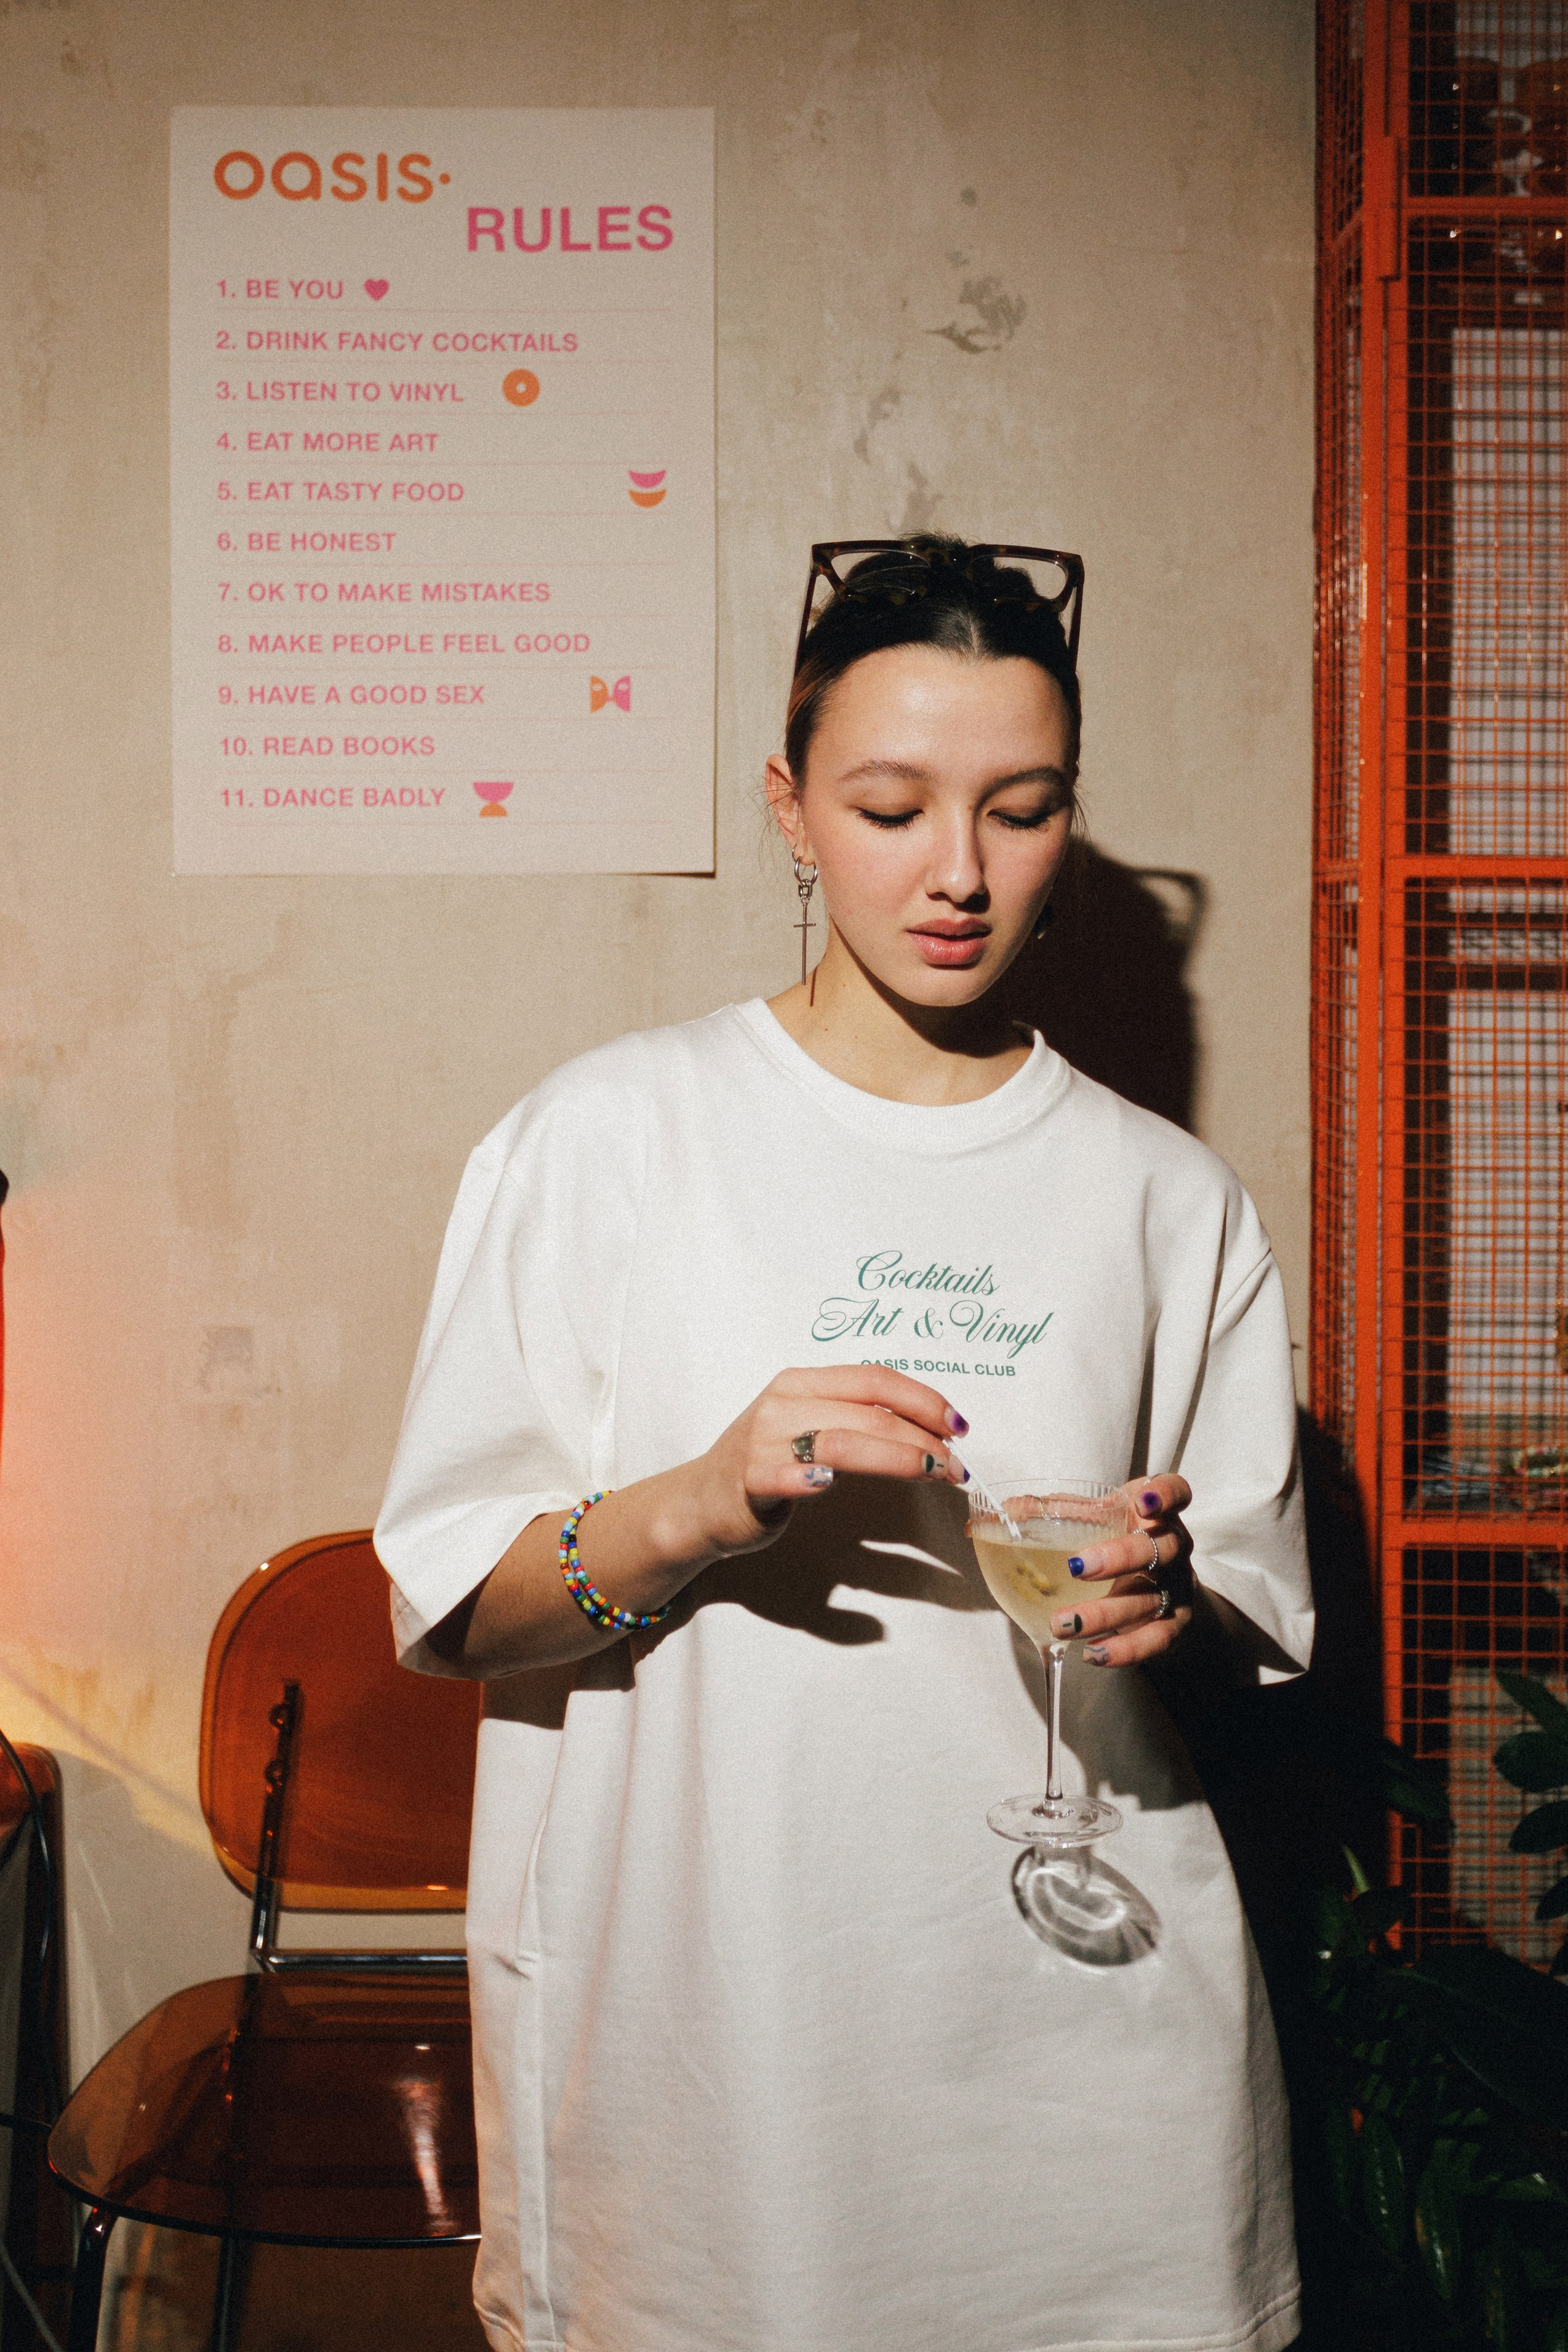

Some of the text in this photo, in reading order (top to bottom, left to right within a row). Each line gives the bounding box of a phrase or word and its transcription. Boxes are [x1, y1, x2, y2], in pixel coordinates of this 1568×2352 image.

[467, 205, 674, 253] RULES
[217, 278, 344, 301] 1. BE YOU
[216, 330, 578, 353] 2. DRINK FANCY COCKTAILS
[216, 380, 464, 403] 3. LISTEN TO VINYL
[216, 431, 439, 453] 4. EAT MORE ART
[217, 481, 465, 502] 5. EAT TASTY FOOD
[216, 531, 396, 552] 6. BE HONEST
[217, 582, 551, 603] 7. OK TO MAKE MISTAKES
[217, 633, 590, 654] 8. MAKE PEOPLE FEEL GOOD
[217, 684, 484, 705] 9. HAVE A GOOD SEX
[221, 736, 435, 756] 10. READ BOOKS
[220, 786, 446, 808] 11. DANCE BADLY
[856, 1250, 1001, 1296] Cocktails
[811, 1297, 1055, 1360] Art & Vinyl
[913, 1359, 970, 1374] SOCIAL
[974, 1363, 1016, 1377] CLUB
